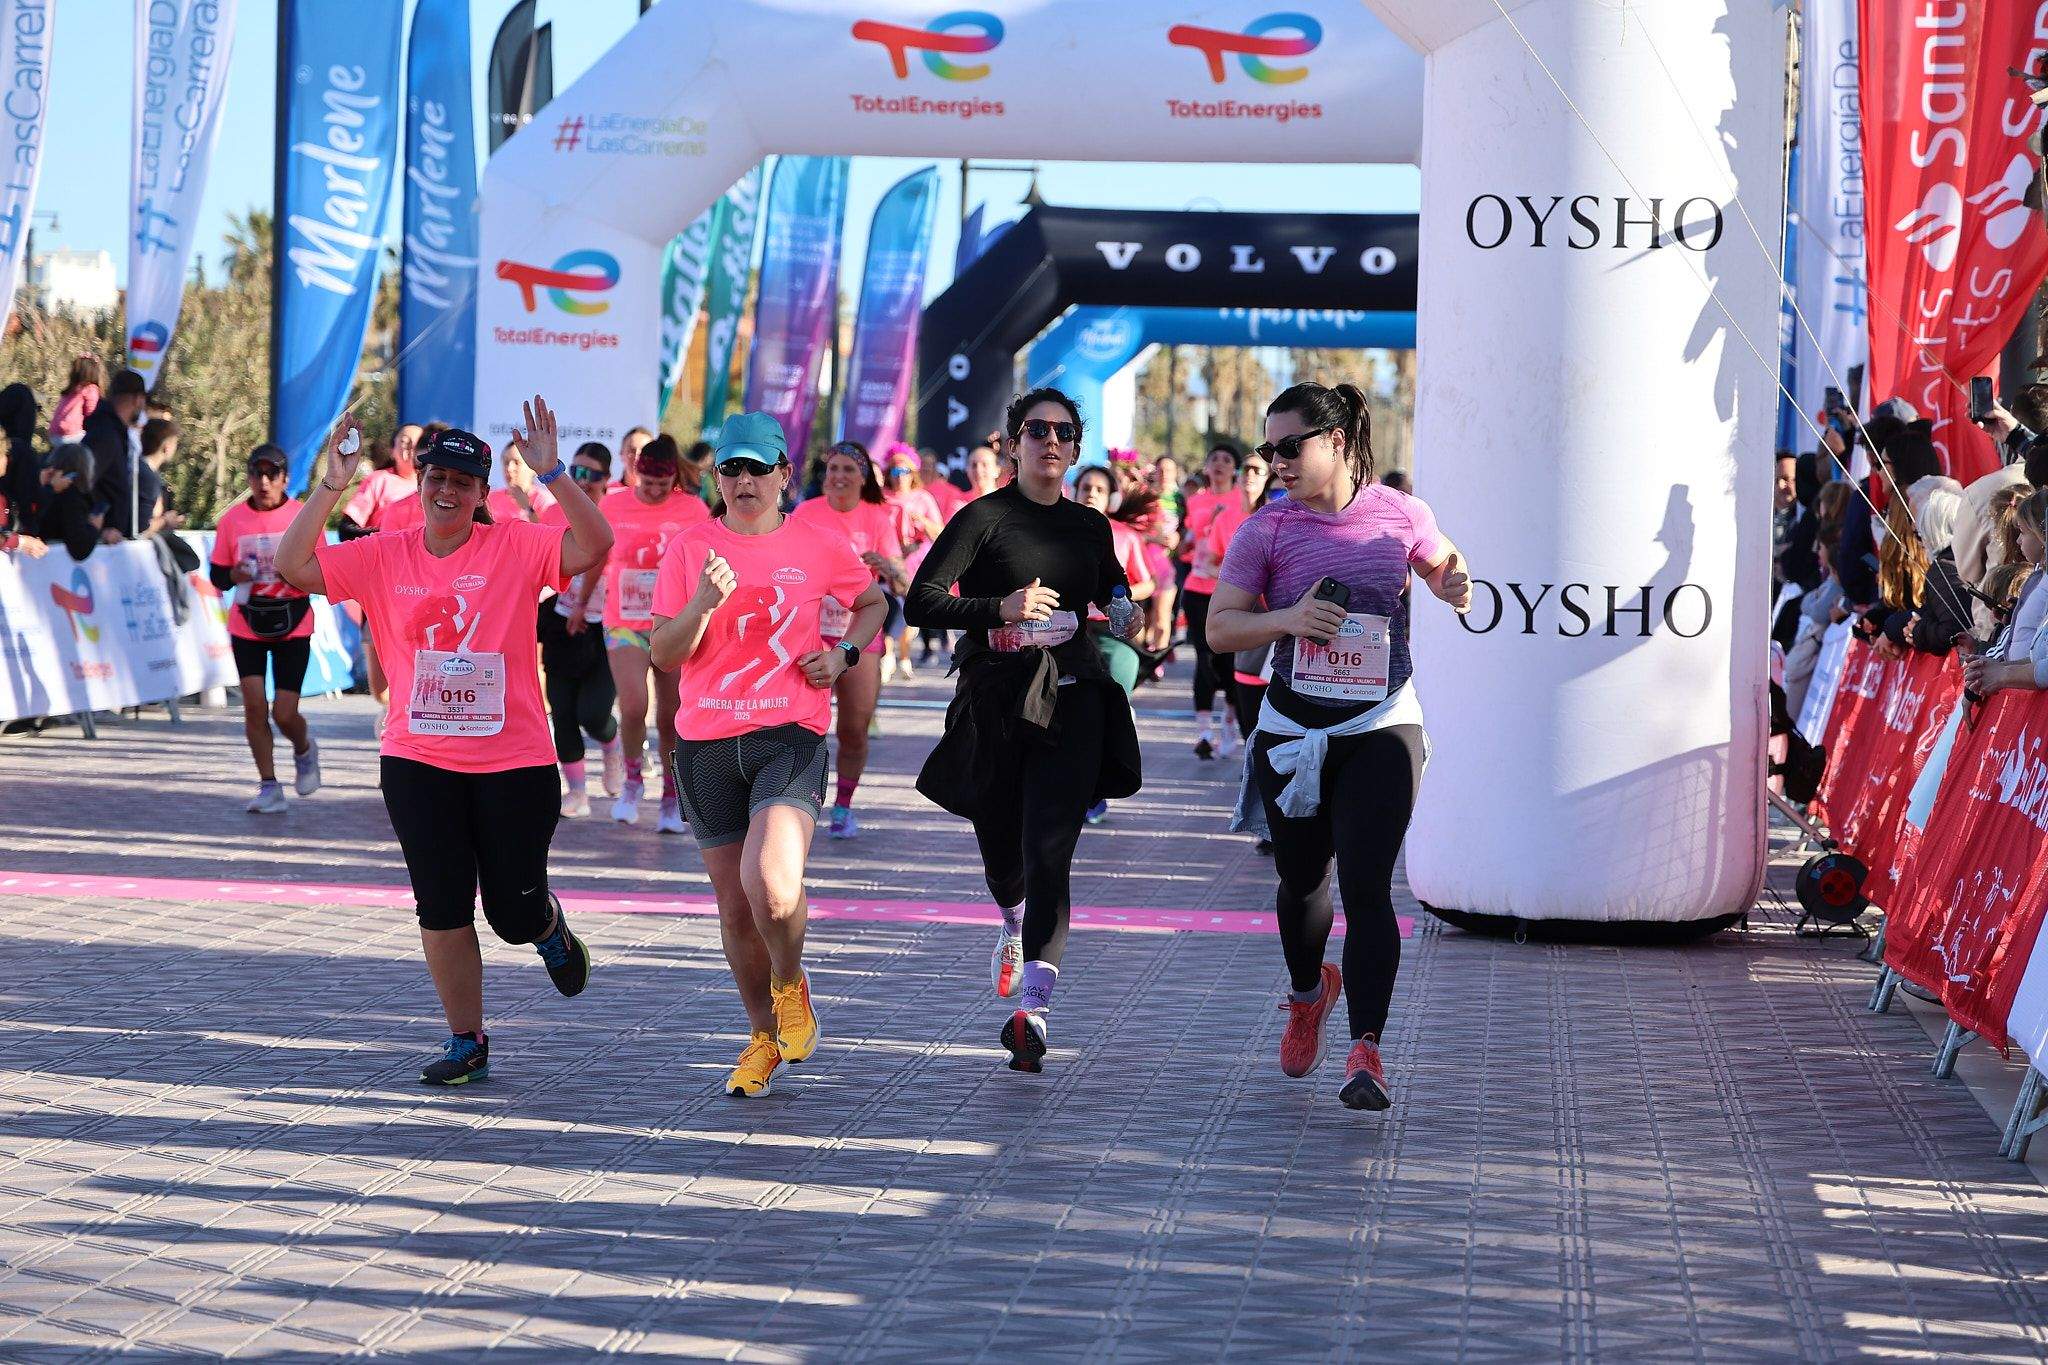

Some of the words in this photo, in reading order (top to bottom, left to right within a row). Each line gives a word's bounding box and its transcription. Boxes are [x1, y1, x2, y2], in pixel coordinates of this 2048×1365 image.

[851, 95, 1005, 119] TotalEnergies
[1167, 99, 1323, 122] TotalEnergies
[288, 63, 382, 296] Marlene
[405, 100, 479, 309] Marlene
[1466, 193, 1725, 251] OYSHO
[1094, 241, 1398, 275] VOLVO
[493, 327, 619, 351] TotalEnergies
[395, 585, 429, 595] OYSHO
[1458, 579, 1713, 638] OYSHO
[1327, 651, 1362, 666] 016
[441, 689, 476, 703] 016
[1302, 684, 1332, 693] OYSHO
[698, 697, 733, 710] CARRERA
[735, 700, 745, 710] DE
[747, 699, 758, 710] LA
[760, 696, 788, 709] MUJER
[734, 711, 750, 720] 2025
